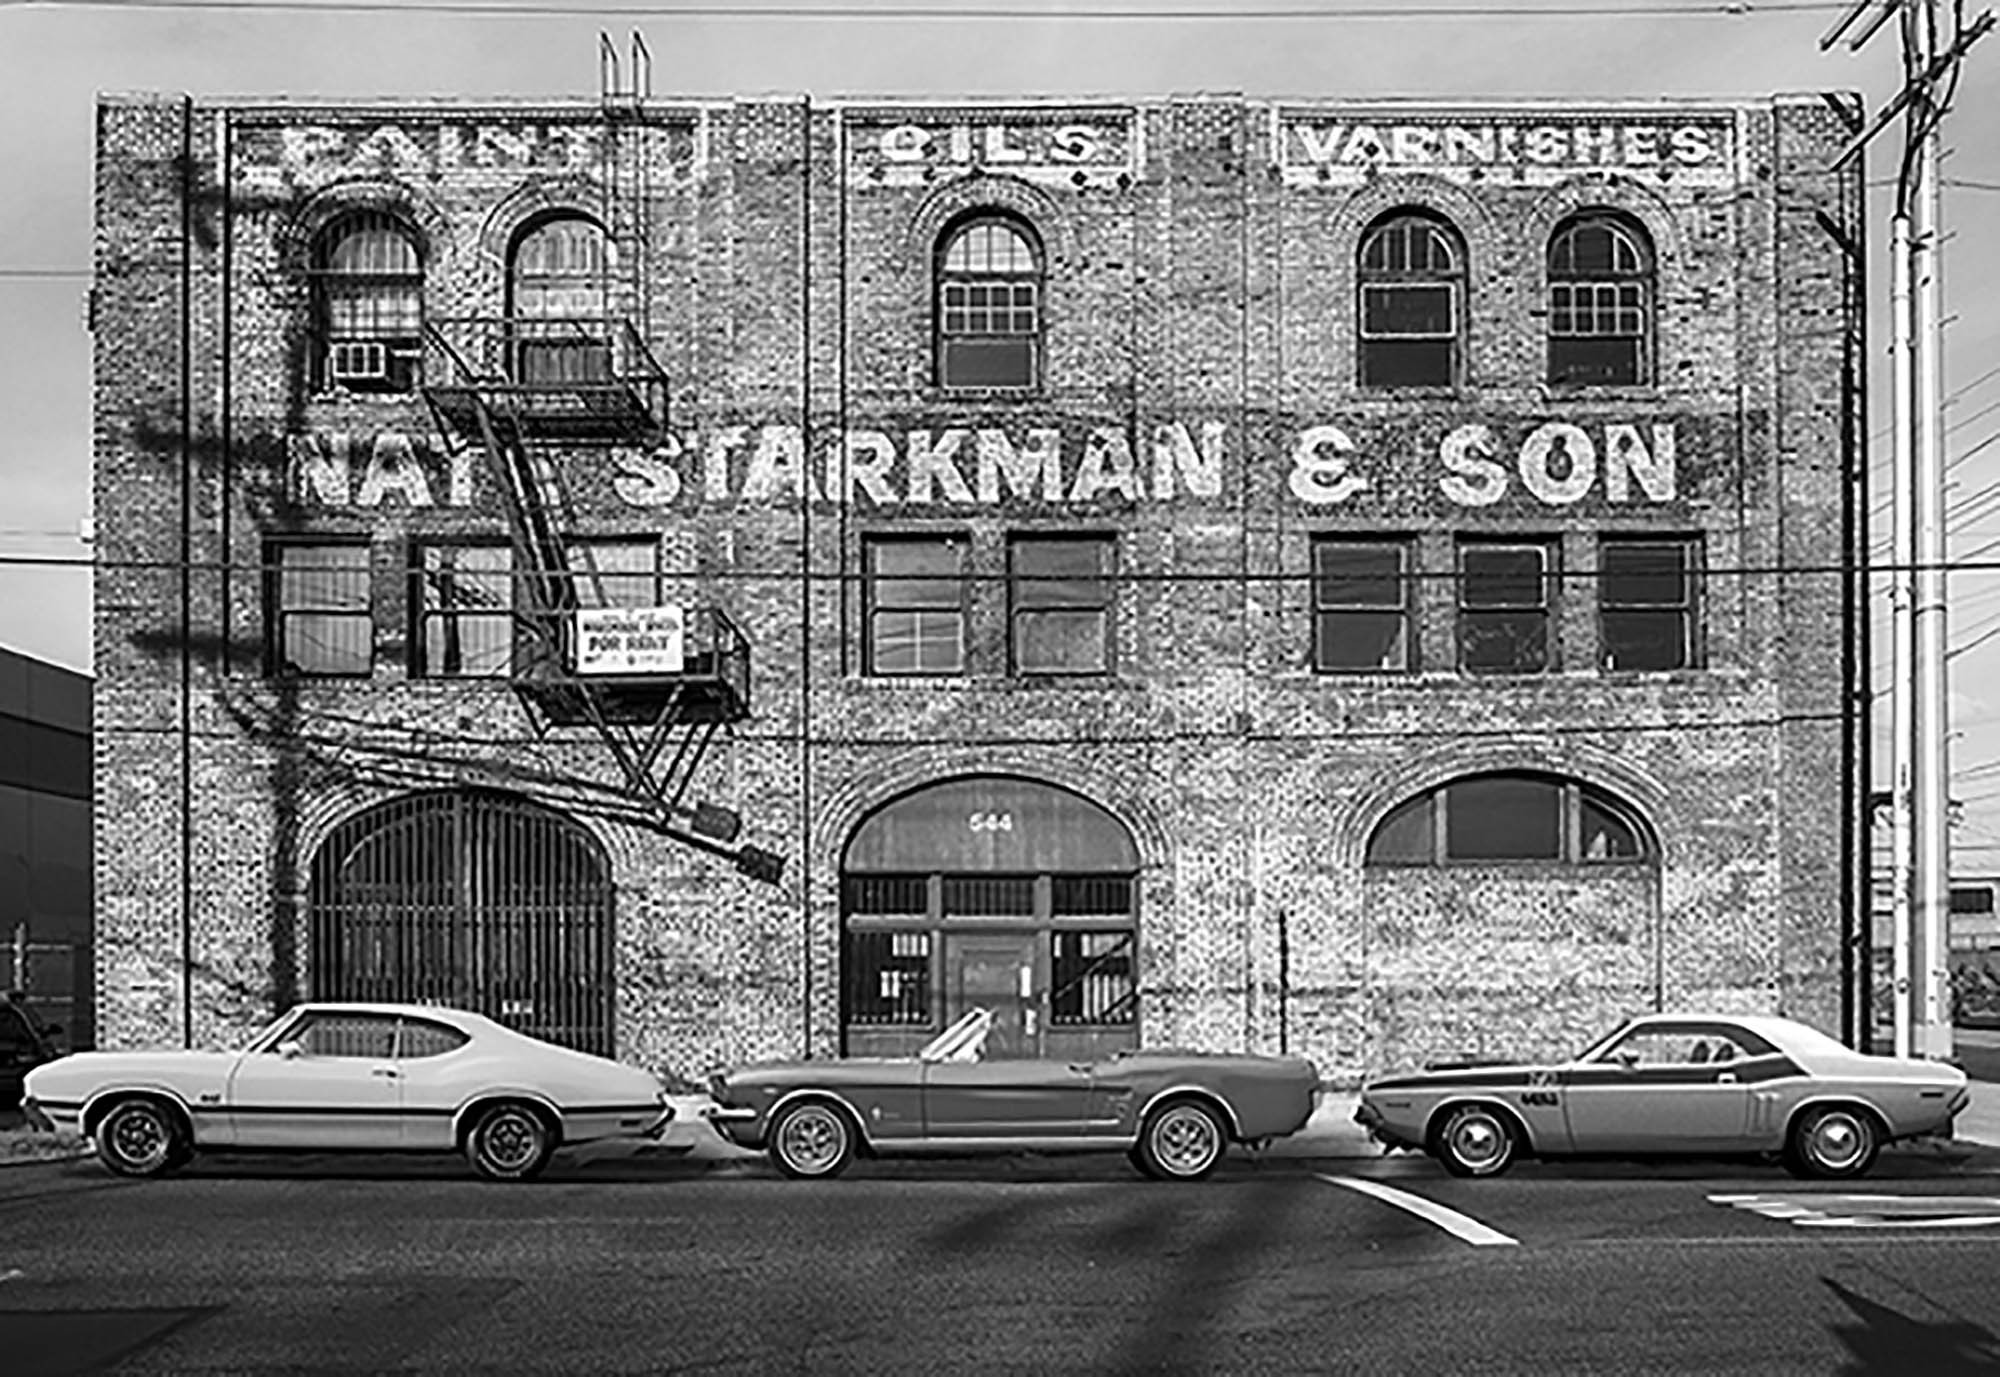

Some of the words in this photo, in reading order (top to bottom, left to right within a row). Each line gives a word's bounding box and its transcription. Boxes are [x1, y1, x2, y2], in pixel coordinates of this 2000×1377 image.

[880, 125, 1101, 162] OILS
[1298, 124, 1714, 164] VARNISHES
[611, 421, 1226, 505] STARKMAN
[1288, 425, 1367, 502] &
[1439, 422, 1676, 506] SON
